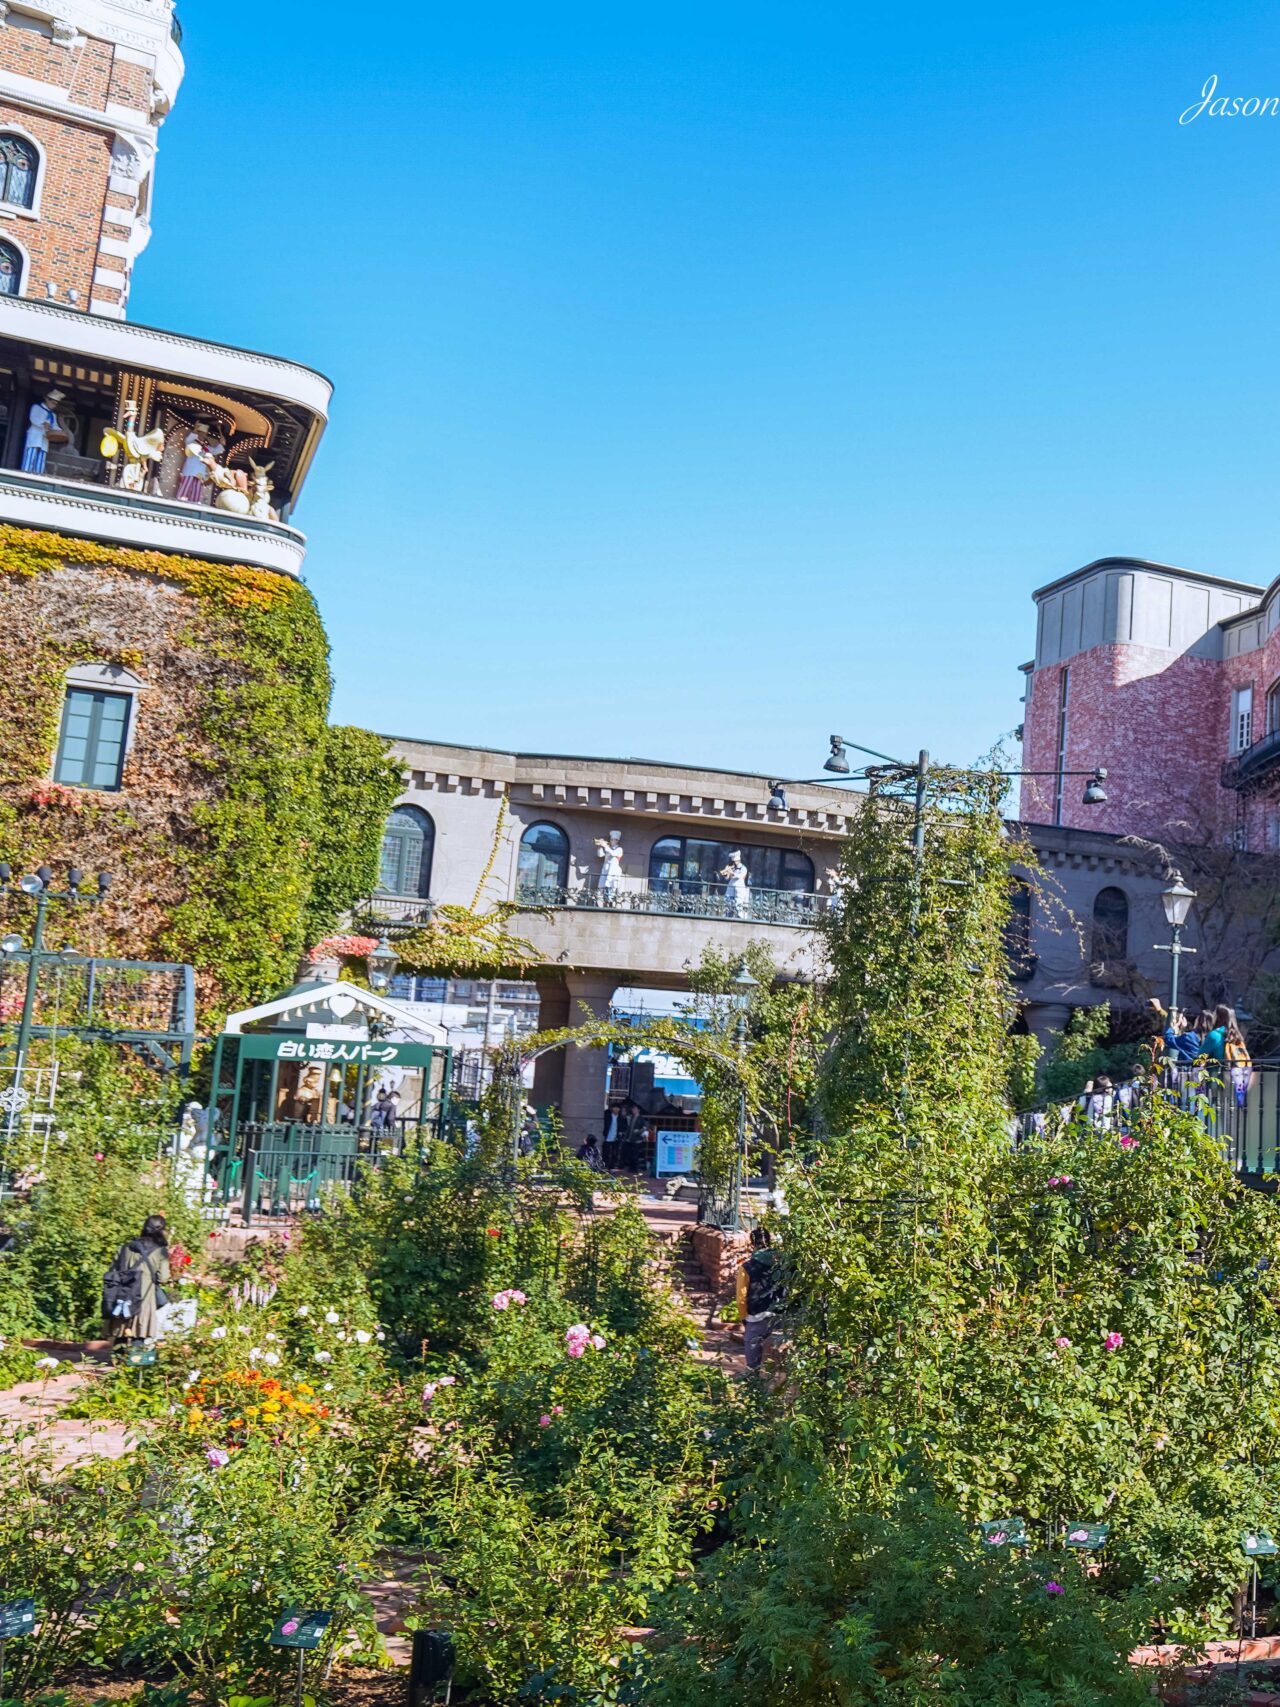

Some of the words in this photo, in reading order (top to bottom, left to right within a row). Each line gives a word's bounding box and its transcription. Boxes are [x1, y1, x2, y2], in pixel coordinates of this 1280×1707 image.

[277, 1040, 399, 1062] 白い恋人パーク
